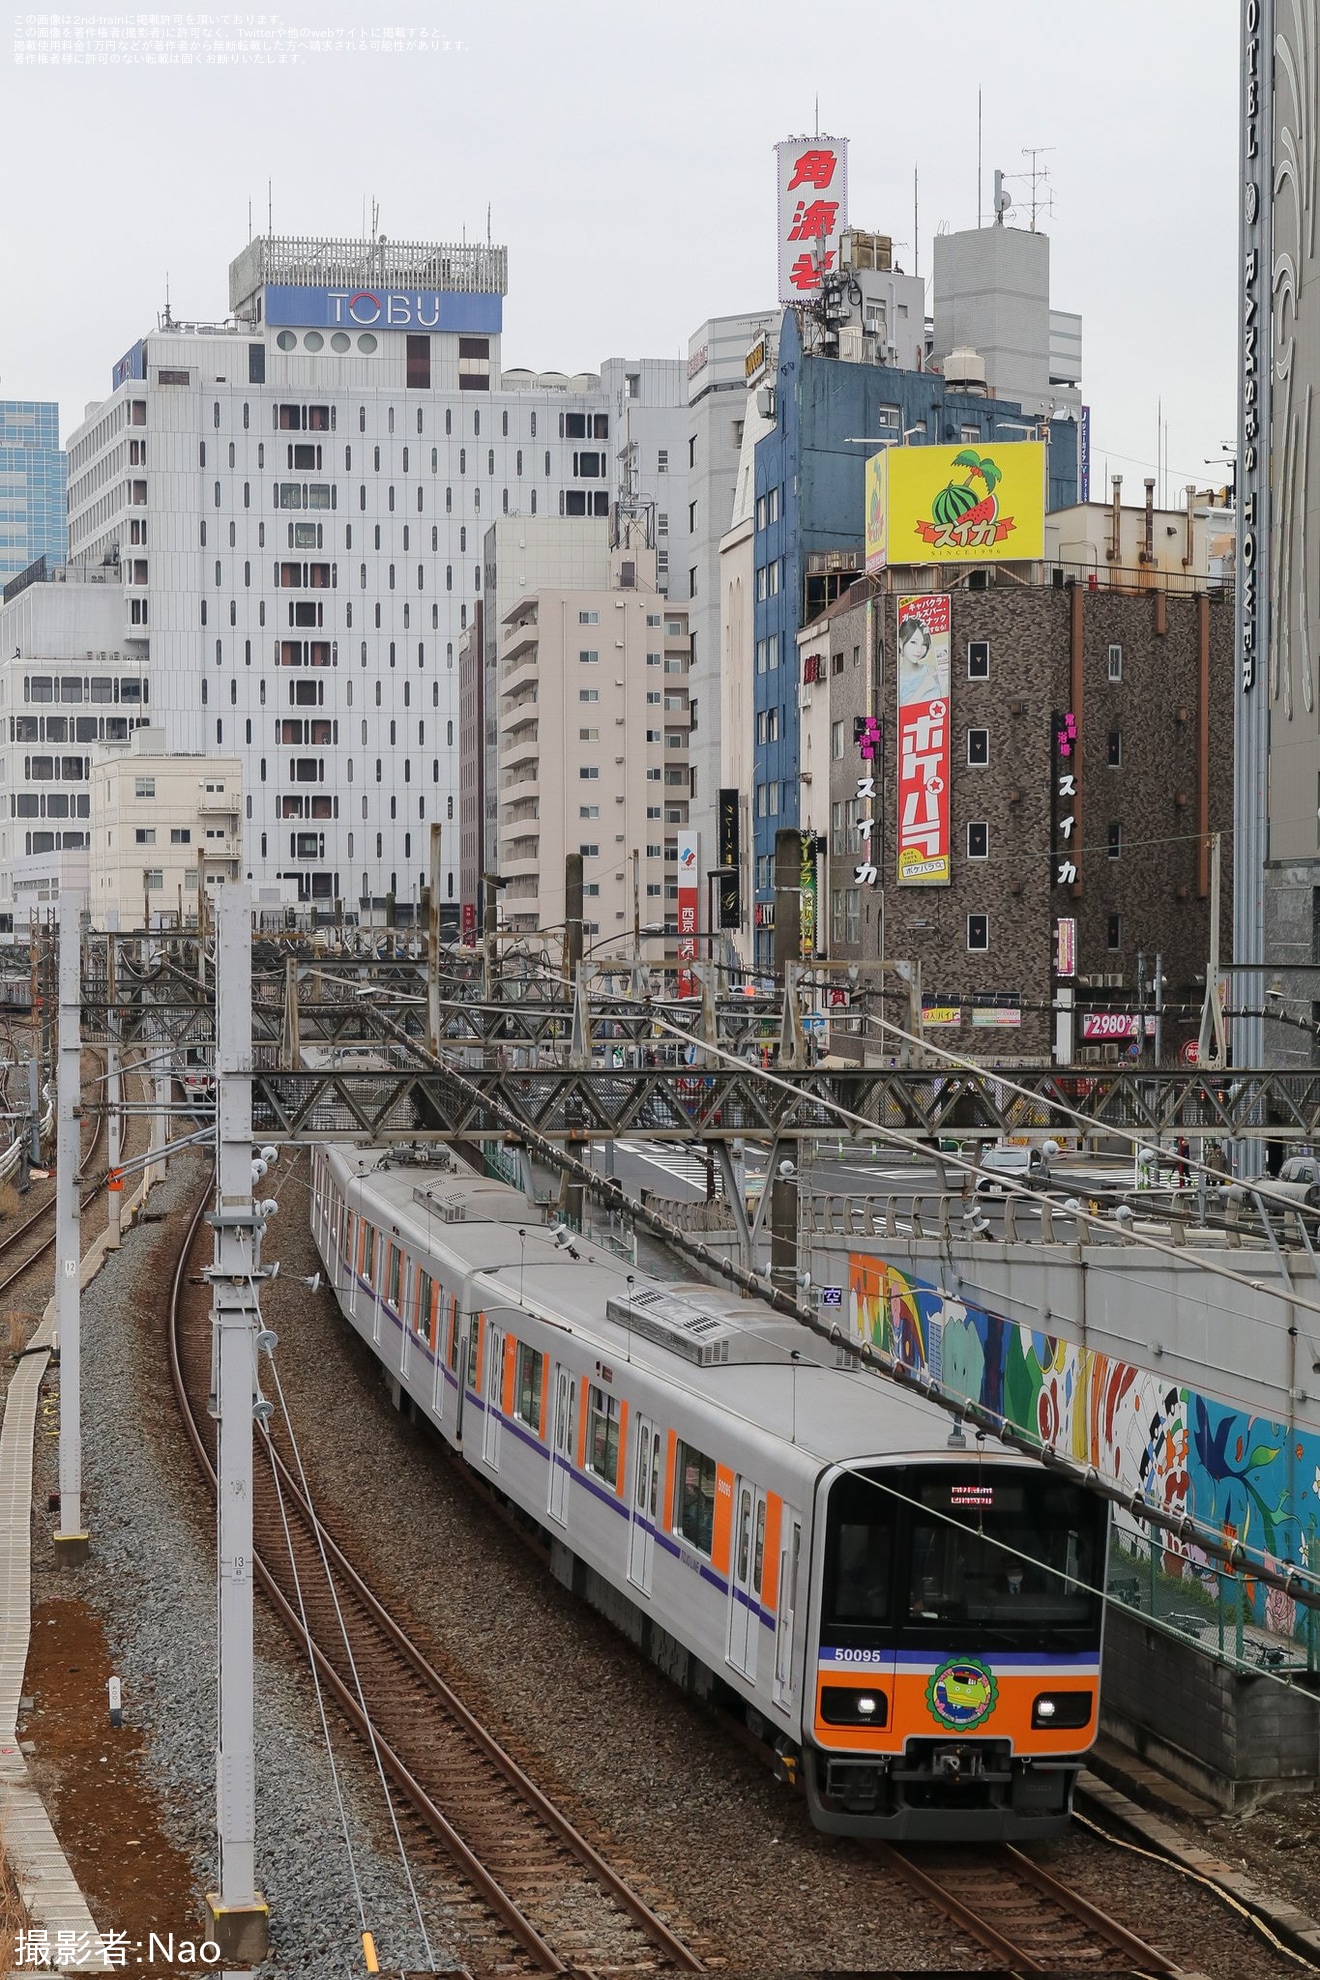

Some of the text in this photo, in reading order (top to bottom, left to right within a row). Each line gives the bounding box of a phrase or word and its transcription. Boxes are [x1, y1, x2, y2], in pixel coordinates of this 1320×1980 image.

[787, 149, 838, 290] 角海老
[328, 292, 440, 327] TOBU
[933, 520, 997, 548] スイカ
[1242, 493, 1257, 693] TOWER
[855, 778, 877, 884] スイカ
[1057, 775, 1076, 884] スイカ
[66, 1262, 75, 1272] 12
[824, 1288, 841, 1305] 空
[234, 1556, 244, 1567] 13
[834, 1648, 881, 1663] 50095
